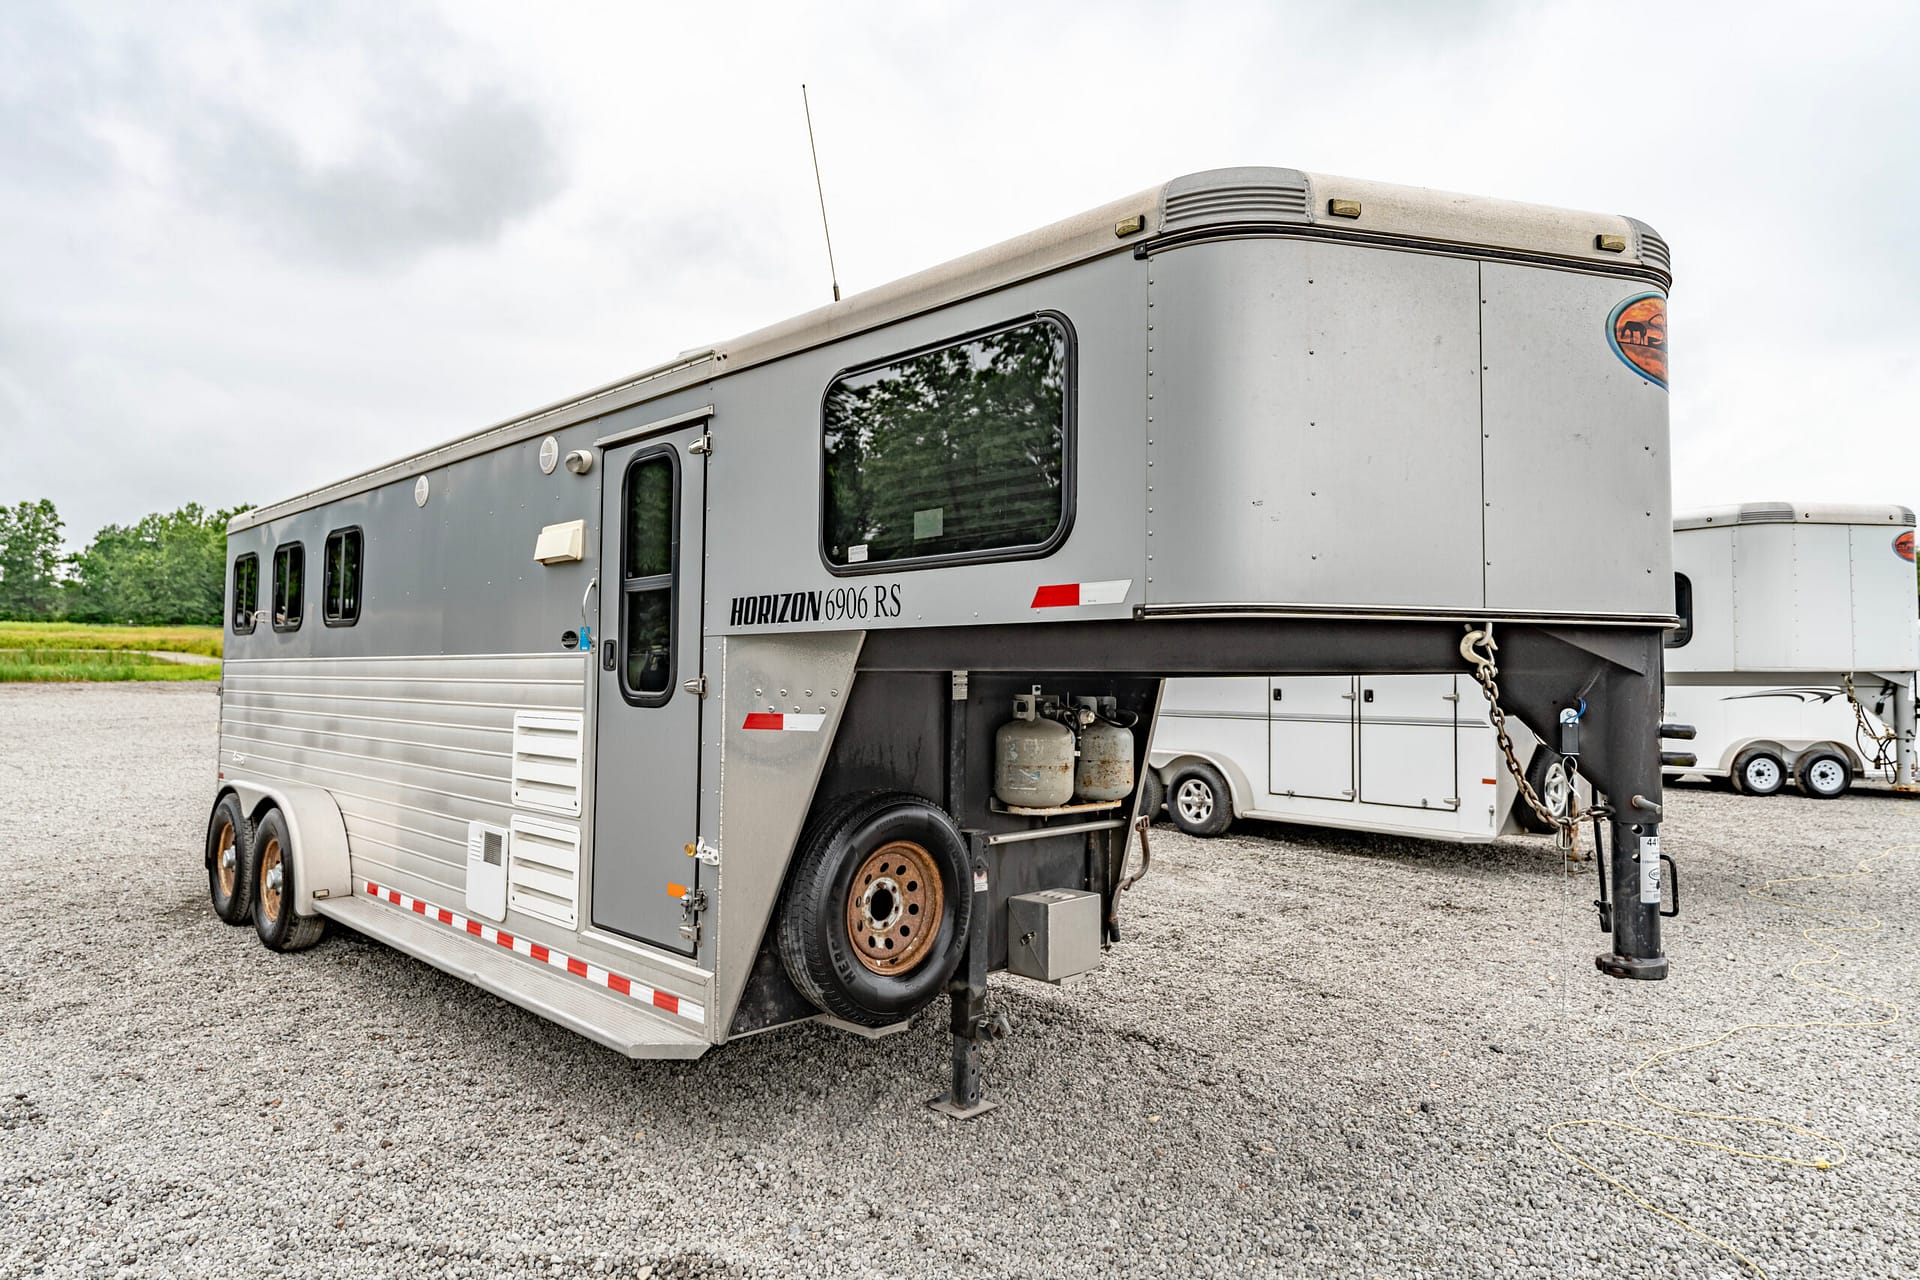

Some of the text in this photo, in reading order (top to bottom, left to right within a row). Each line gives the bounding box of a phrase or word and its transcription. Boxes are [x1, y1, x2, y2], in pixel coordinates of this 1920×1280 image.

[730, 583, 901, 626] HORIZON 6906 RS
